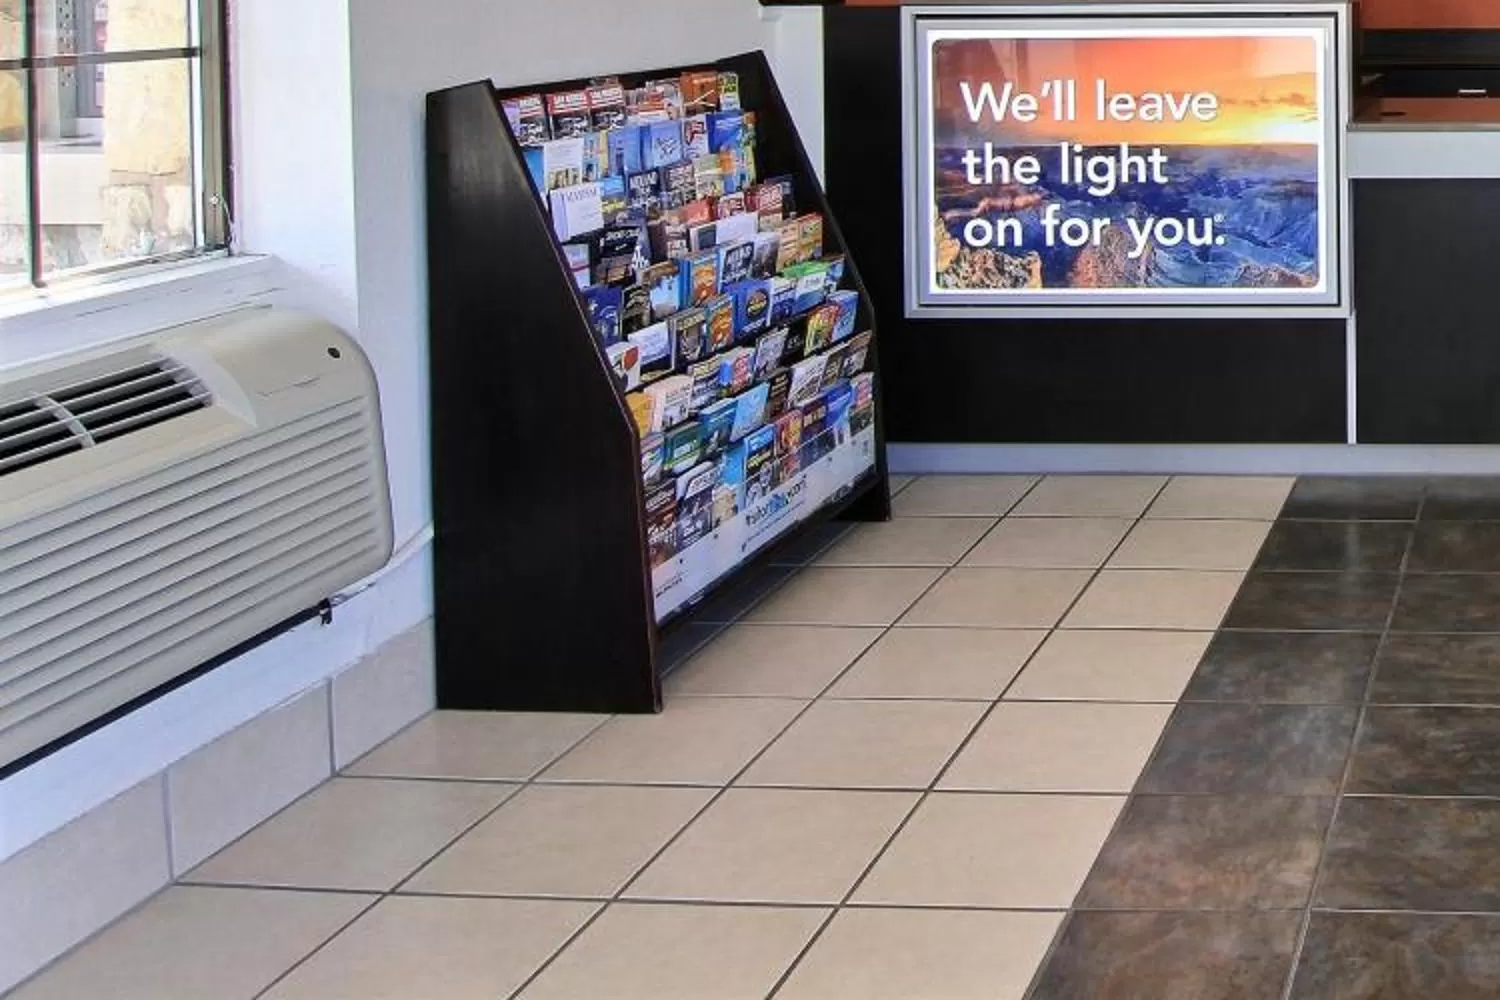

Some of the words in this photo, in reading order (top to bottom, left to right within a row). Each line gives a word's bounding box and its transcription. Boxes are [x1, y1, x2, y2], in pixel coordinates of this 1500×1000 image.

[959, 79, 1075, 122] We'll
[1096, 78, 1218, 122] leave
[961, 142, 1040, 185] the
[1060, 142, 1169, 196] light
[963, 214, 1023, 247] on
[1041, 204, 1111, 246] for
